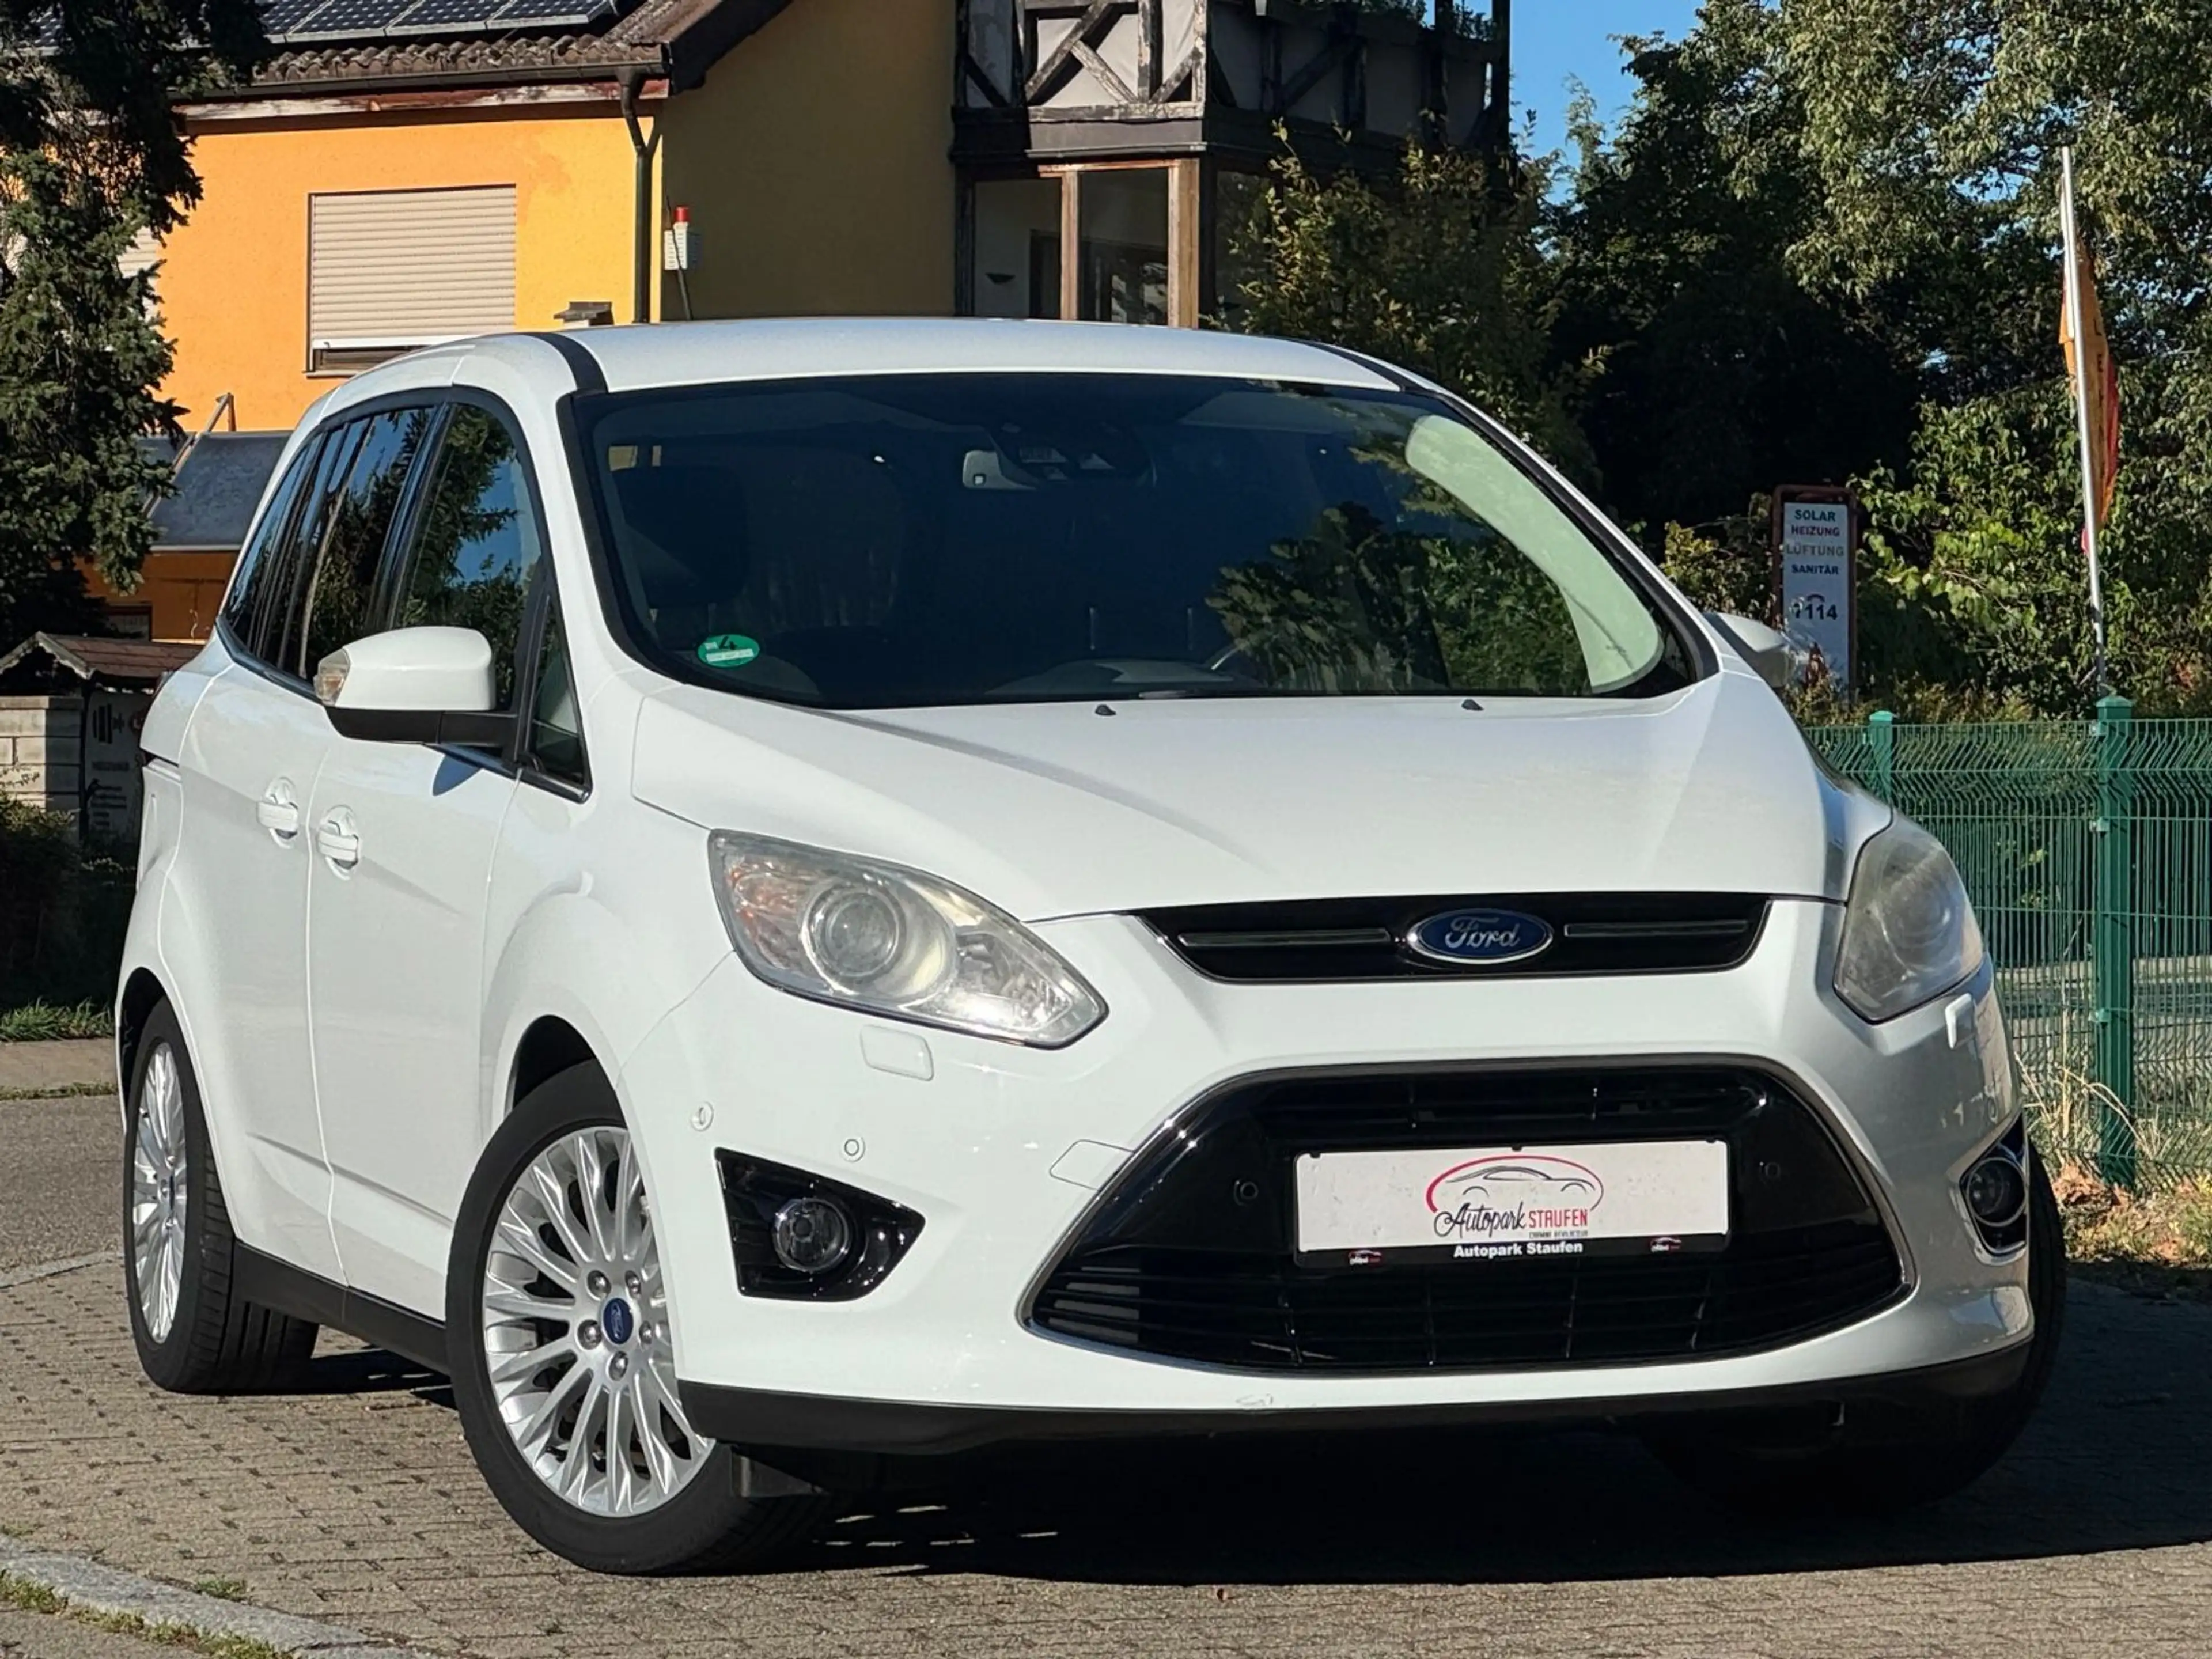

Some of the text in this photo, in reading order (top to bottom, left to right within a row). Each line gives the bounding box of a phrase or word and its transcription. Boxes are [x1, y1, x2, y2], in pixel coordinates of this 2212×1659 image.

[1794, 509, 1836, 522] SOLAR
[1791, 525, 1840, 537] HEIZUNG
[1786, 543, 1844, 557] LÜFTUNG
[719, 635, 736, 650] 4
[1444, 916, 1522, 948] Ford
[1433, 1201, 1588, 1238] Autopark STAUFEN
[1453, 1241, 1583, 1259] Autopark Staufen
